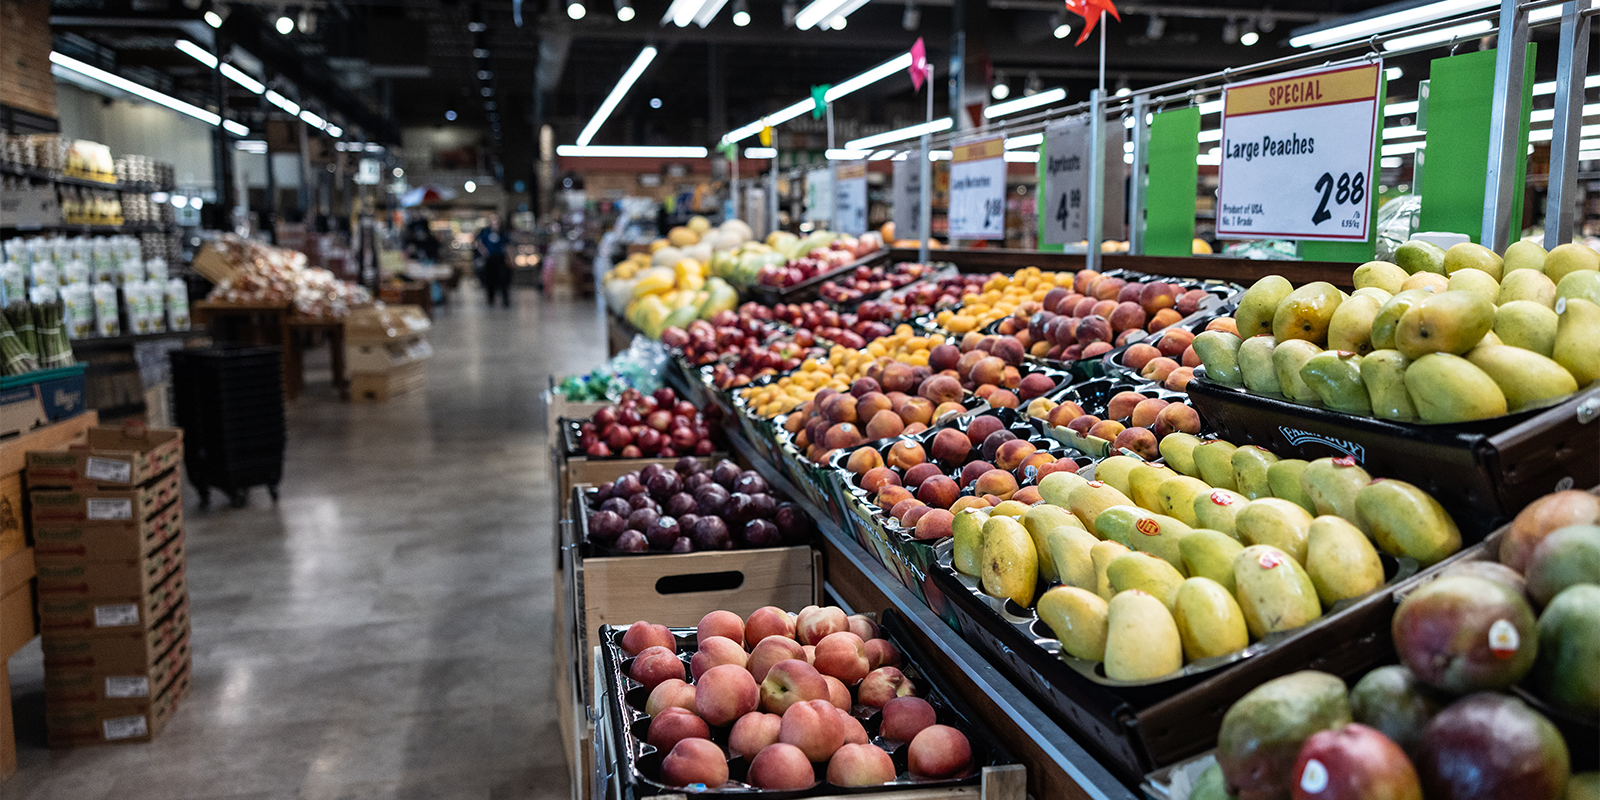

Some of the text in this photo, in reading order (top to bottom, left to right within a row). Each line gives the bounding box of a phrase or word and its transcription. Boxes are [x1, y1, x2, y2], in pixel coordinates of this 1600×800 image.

[1269, 79, 1323, 106] SPECIAL
[1226, 132, 1315, 162] Large Peaches
[1223, 203, 1243, 215] Product
[1283, 426, 1321, 441] FA
